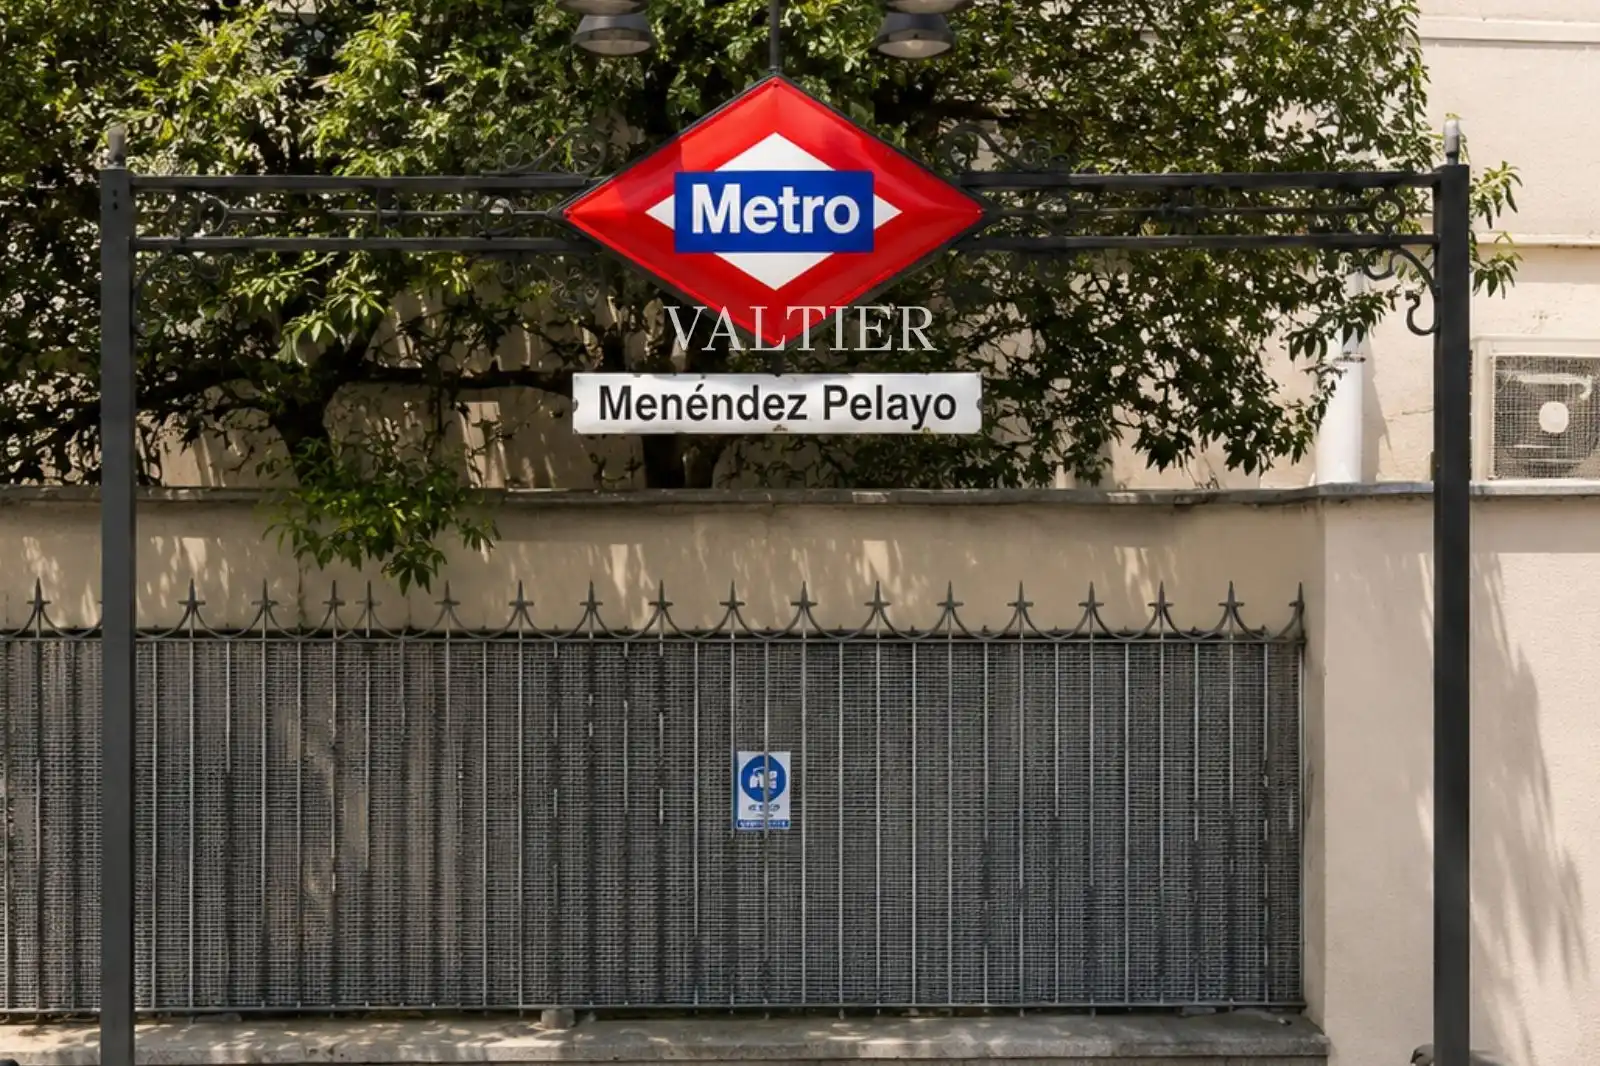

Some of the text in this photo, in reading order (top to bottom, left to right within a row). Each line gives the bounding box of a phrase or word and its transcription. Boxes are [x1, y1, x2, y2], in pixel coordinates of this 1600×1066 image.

[692, 183, 860, 235] Metro
[599, 383, 957, 430] Menéndez Pelayo
